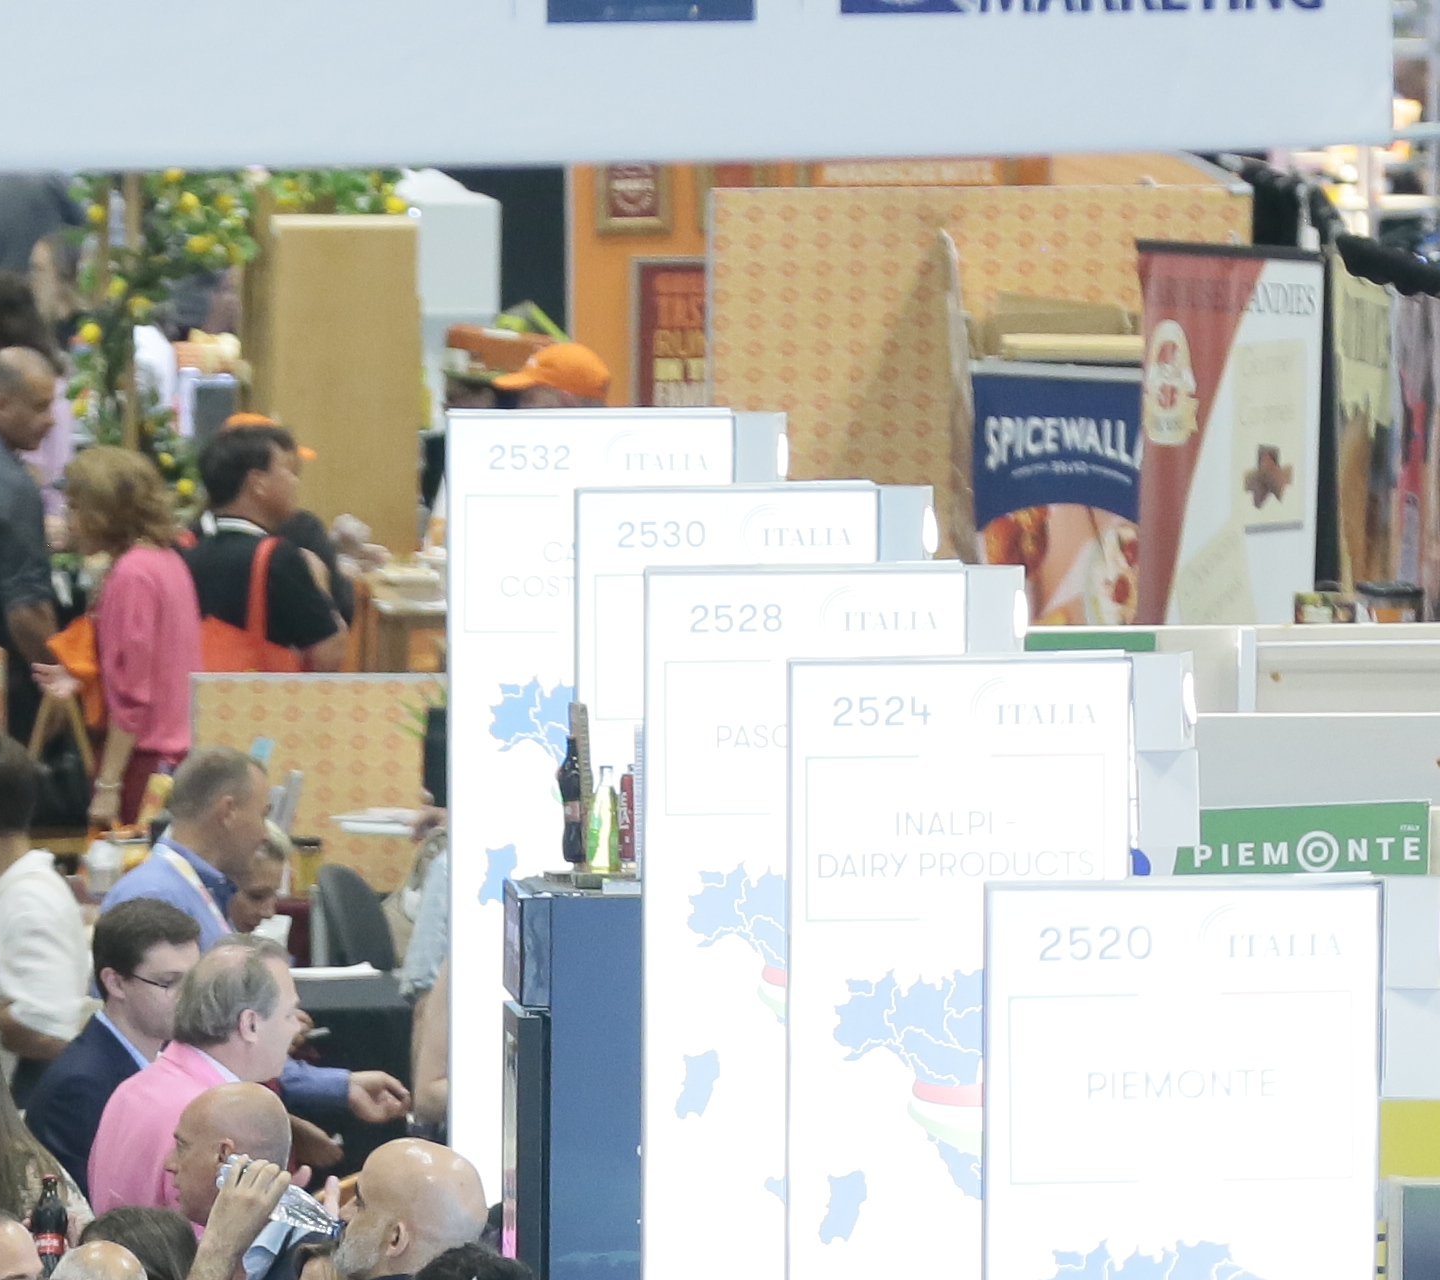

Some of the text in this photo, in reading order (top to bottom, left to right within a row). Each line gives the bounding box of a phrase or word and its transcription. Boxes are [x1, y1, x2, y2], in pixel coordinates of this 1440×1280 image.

[487, 444, 708, 472] 2532 ITALIA
[616, 520, 851, 549] 2530 ITALIA
[689, 603, 937, 633] 2528 ITALIA
[832, 695, 1096, 727] 2524 ITALIA
[894, 810, 994, 837] INALPI
[818, 849, 1094, 878] DAIRY PRODUCTS
[1193, 830, 1422, 873] PIEMONTE
[1038, 924, 1343, 962] 2520 ITALIA
[1087, 1068, 1277, 1100] PIEMONTE
